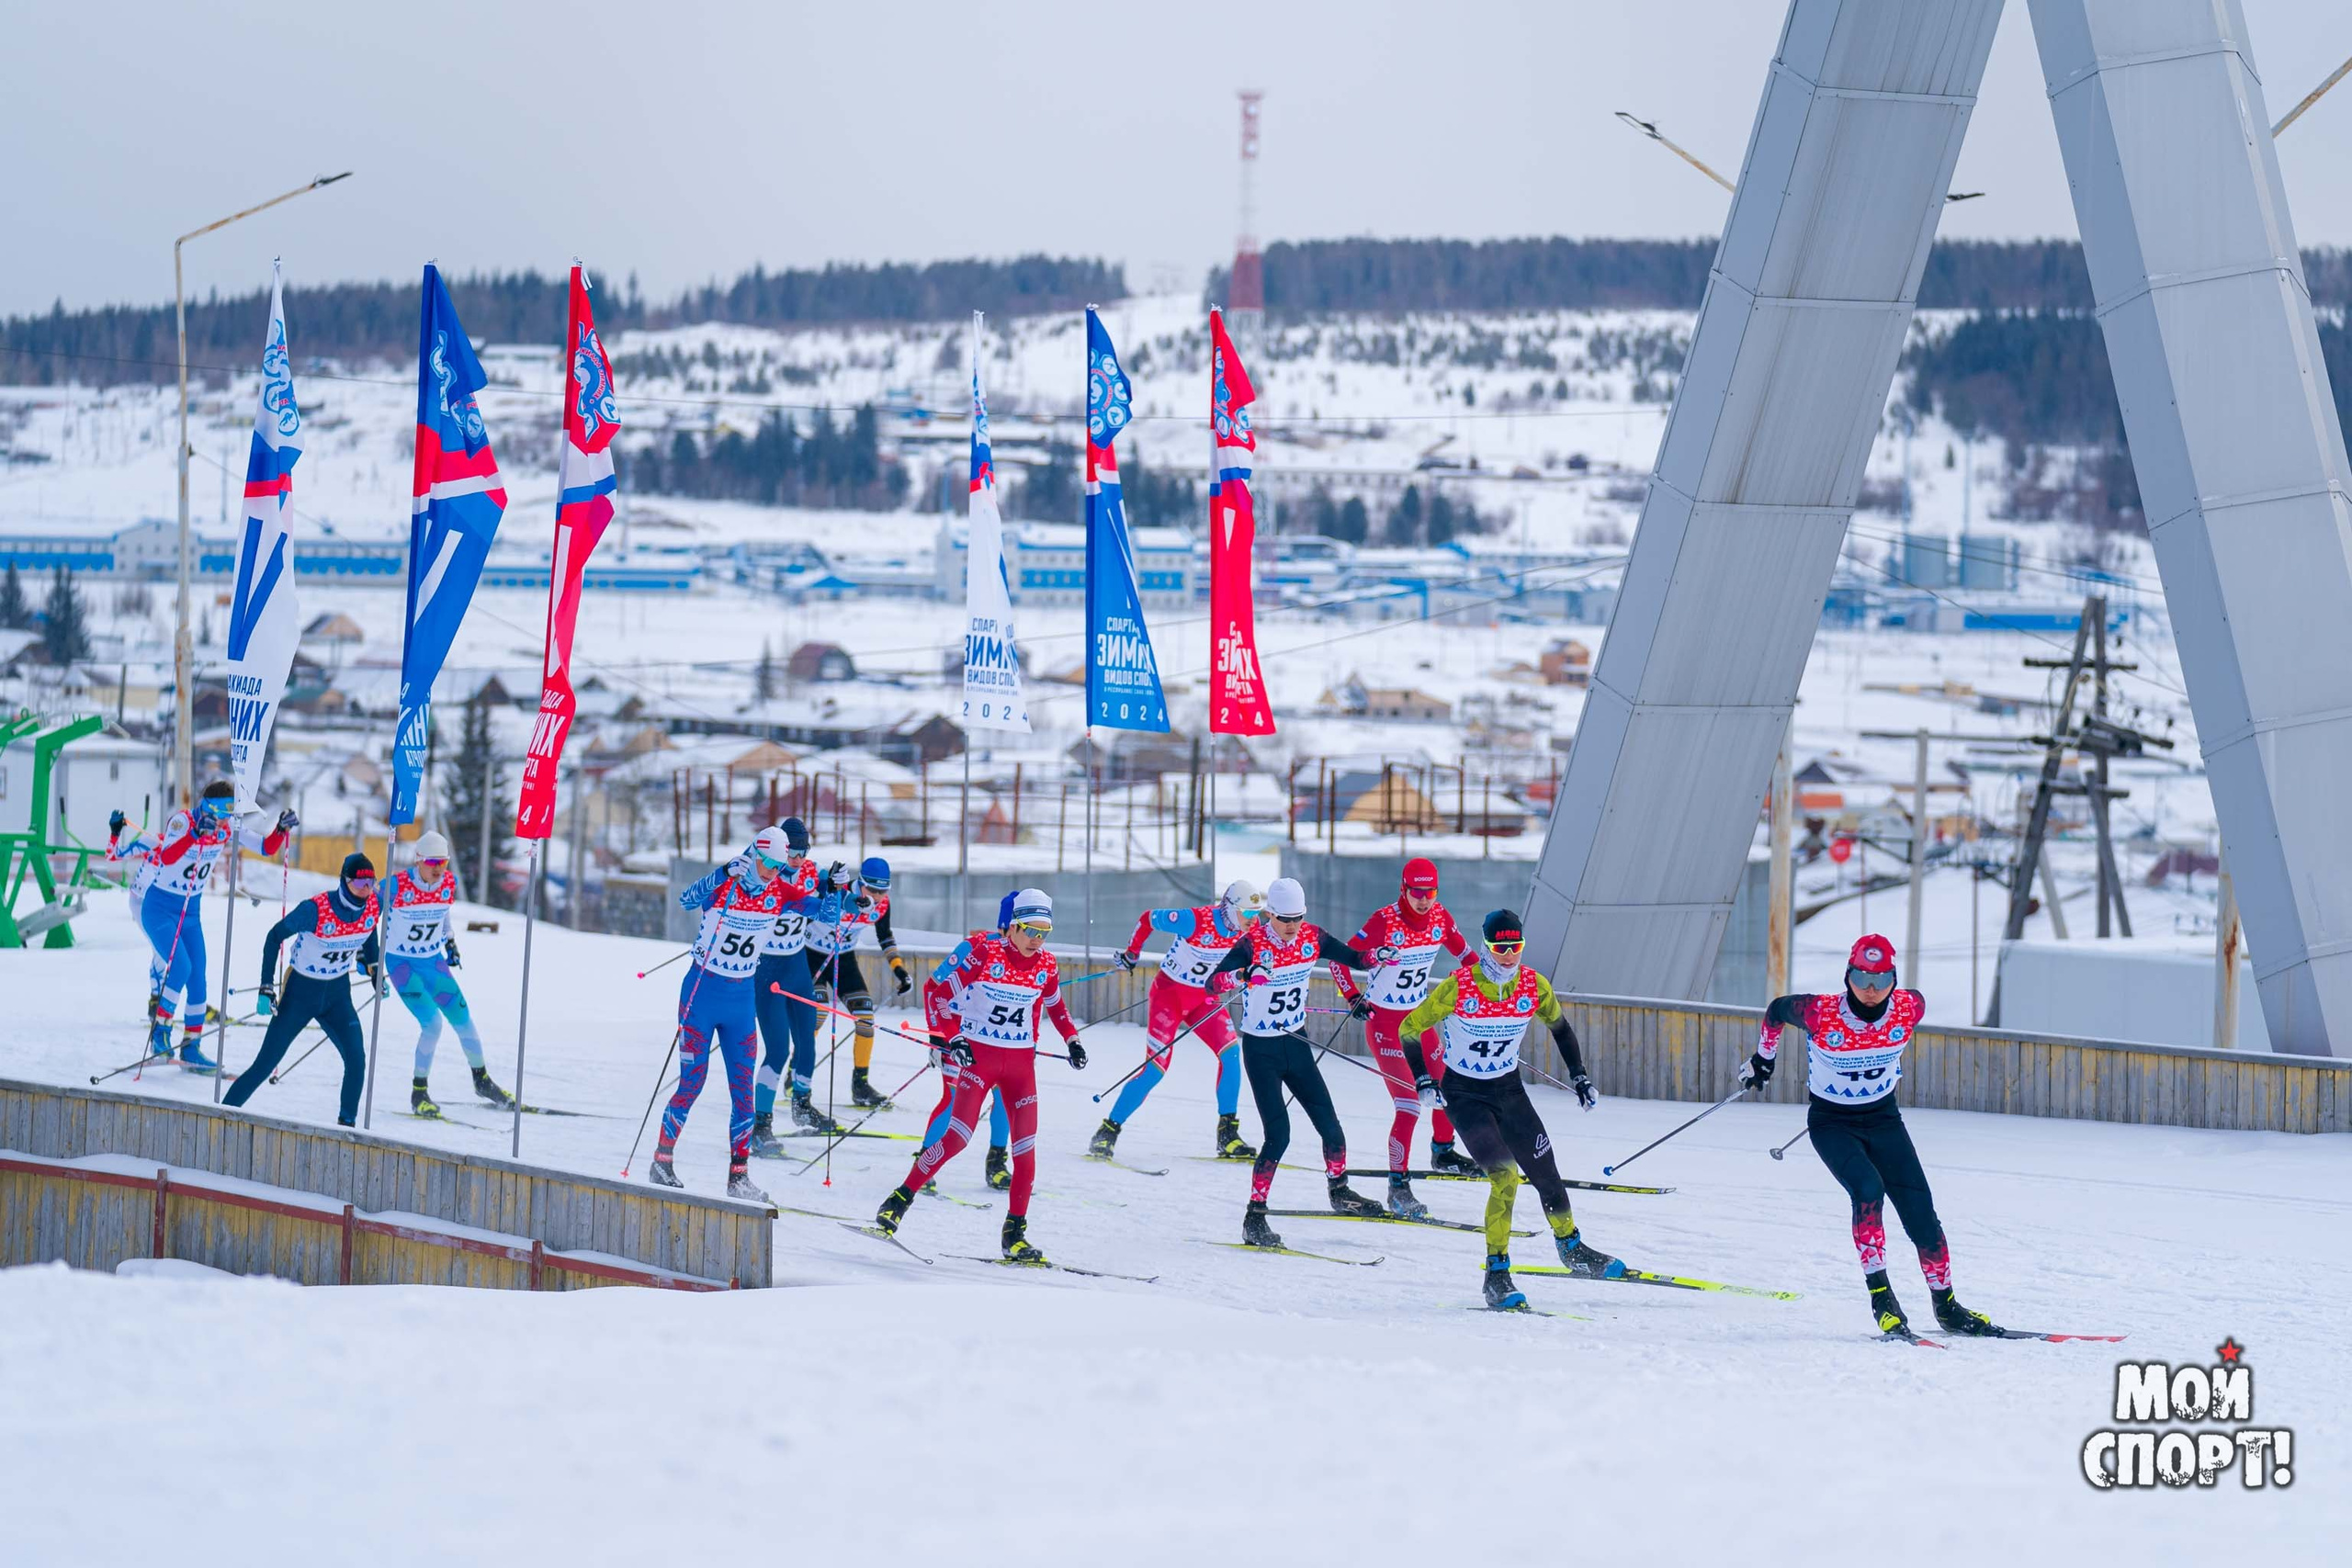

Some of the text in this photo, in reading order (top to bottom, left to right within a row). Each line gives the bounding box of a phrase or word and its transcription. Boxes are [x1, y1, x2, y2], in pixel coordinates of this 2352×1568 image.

[967, 669, 997, 685] ВИДОВ
[1103, 669, 1132, 685] ВИДОВ
[183, 863, 211, 879] 60
[408, 922, 440, 942] 57
[774, 916, 804, 937] 52
[695, 946, 706, 958] 56
[719, 932, 756, 958] 56
[1166, 959, 1178, 971] 51
[1396, 966, 1428, 989] 55
[1267, 987, 1302, 1015] 53
[987, 1005, 1025, 1028] 54
[1468, 1038, 1514, 1058] 47
[961, 1068, 986, 1089] LUKOIL
